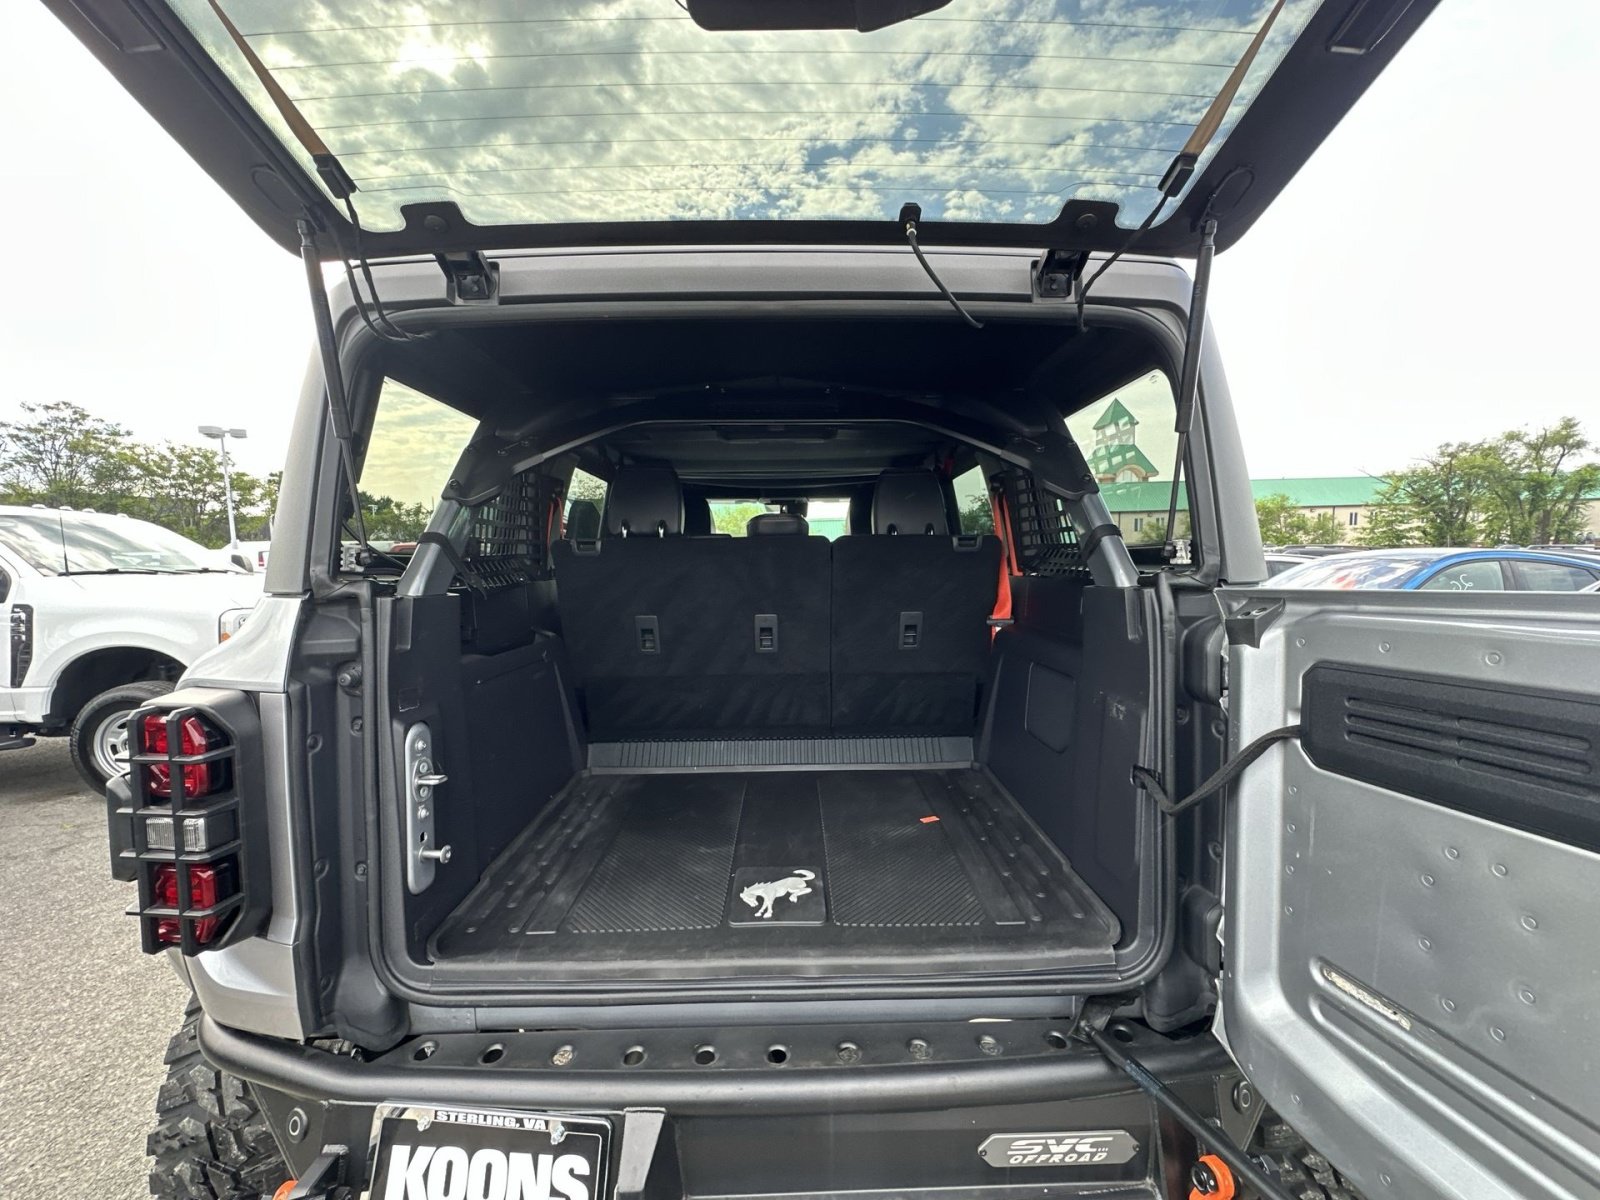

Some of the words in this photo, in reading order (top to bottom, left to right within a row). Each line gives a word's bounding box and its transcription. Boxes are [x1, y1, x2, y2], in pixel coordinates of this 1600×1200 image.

[523, 1118, 547, 1131] VA
[1009, 1152, 1108, 1165] OFFROAD
[383, 1144, 591, 1200] KOONS
